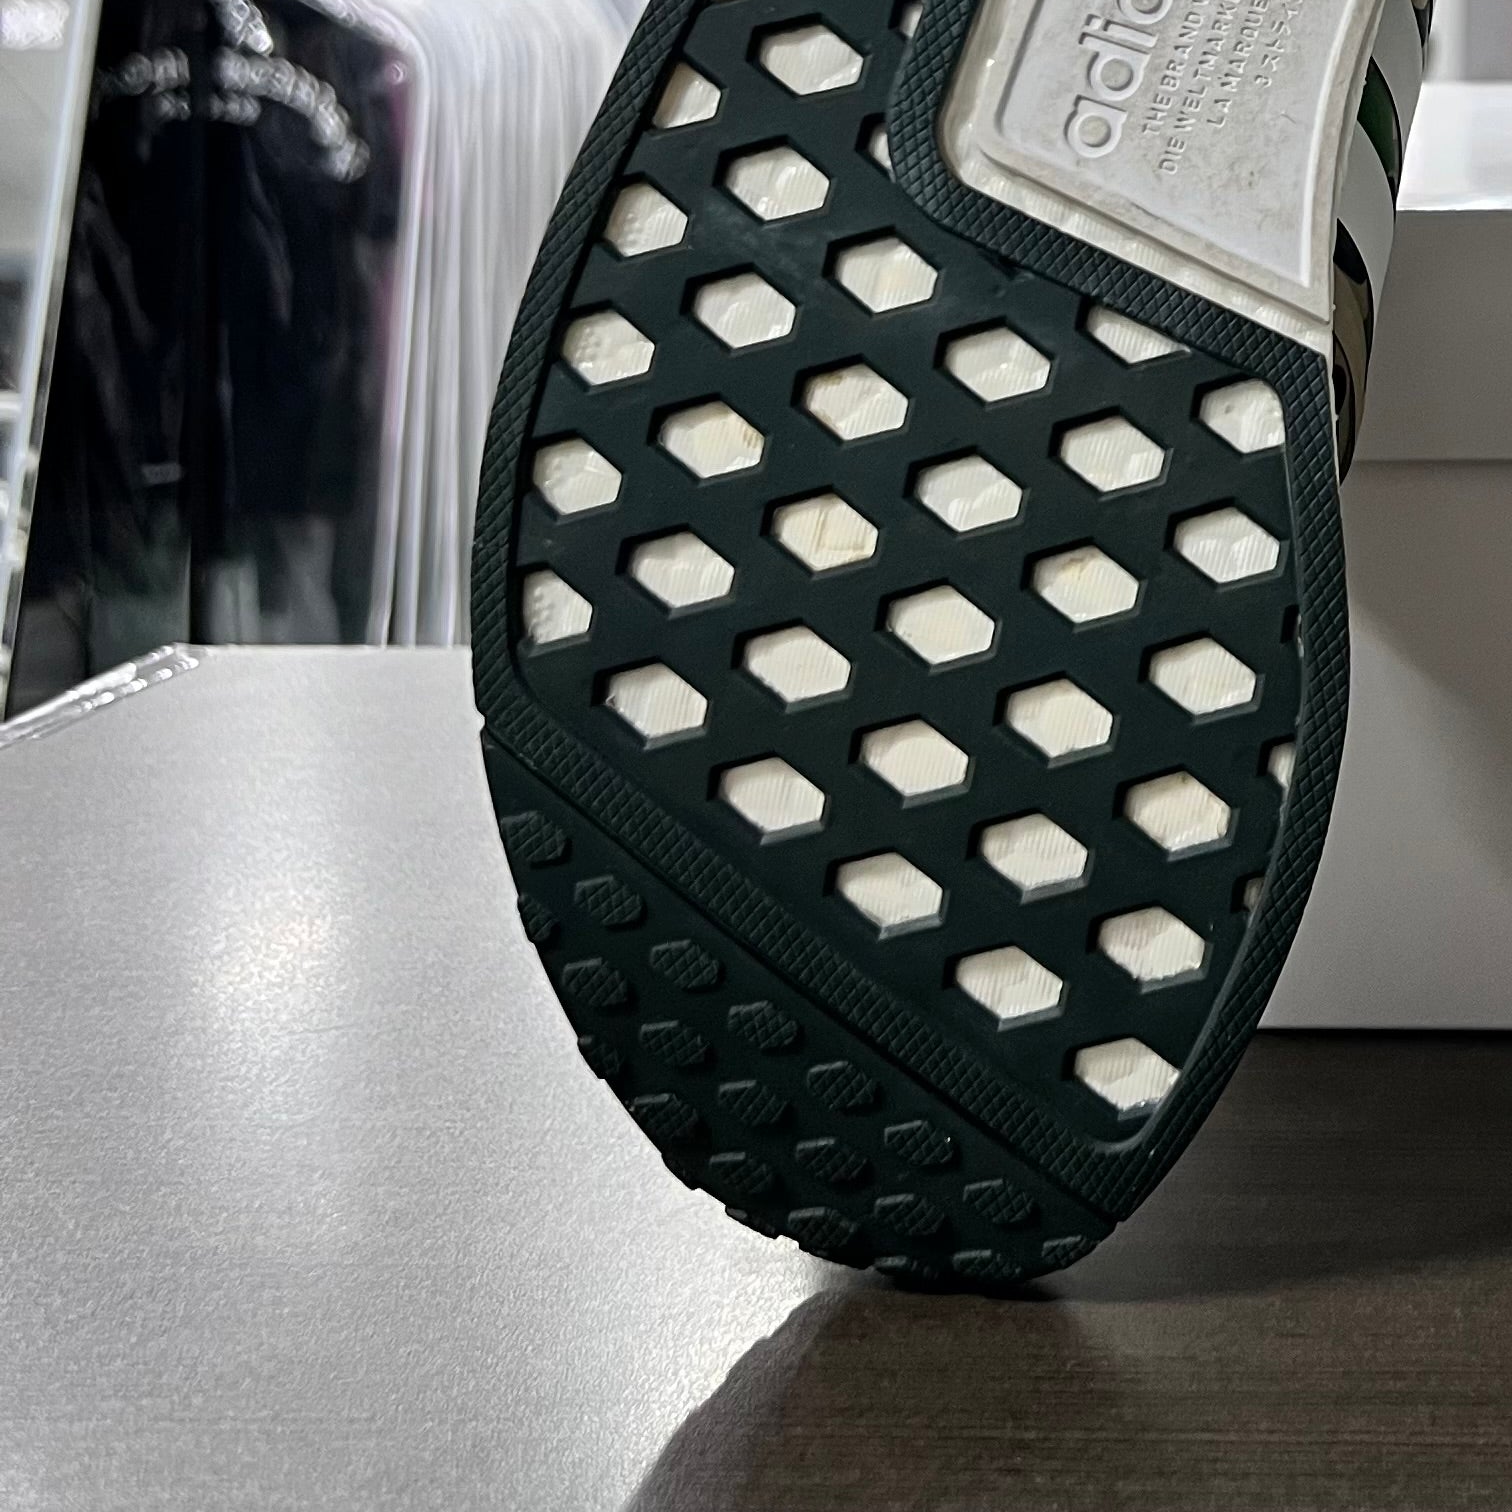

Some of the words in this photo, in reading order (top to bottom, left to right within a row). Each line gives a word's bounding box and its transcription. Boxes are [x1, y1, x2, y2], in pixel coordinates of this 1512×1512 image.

[1142, 92, 1172, 135] THE
[1160, 11, 1203, 92] BRAND
[1206, 98, 1233, 128] LA
[1159, 136, 1186, 175] DIE
